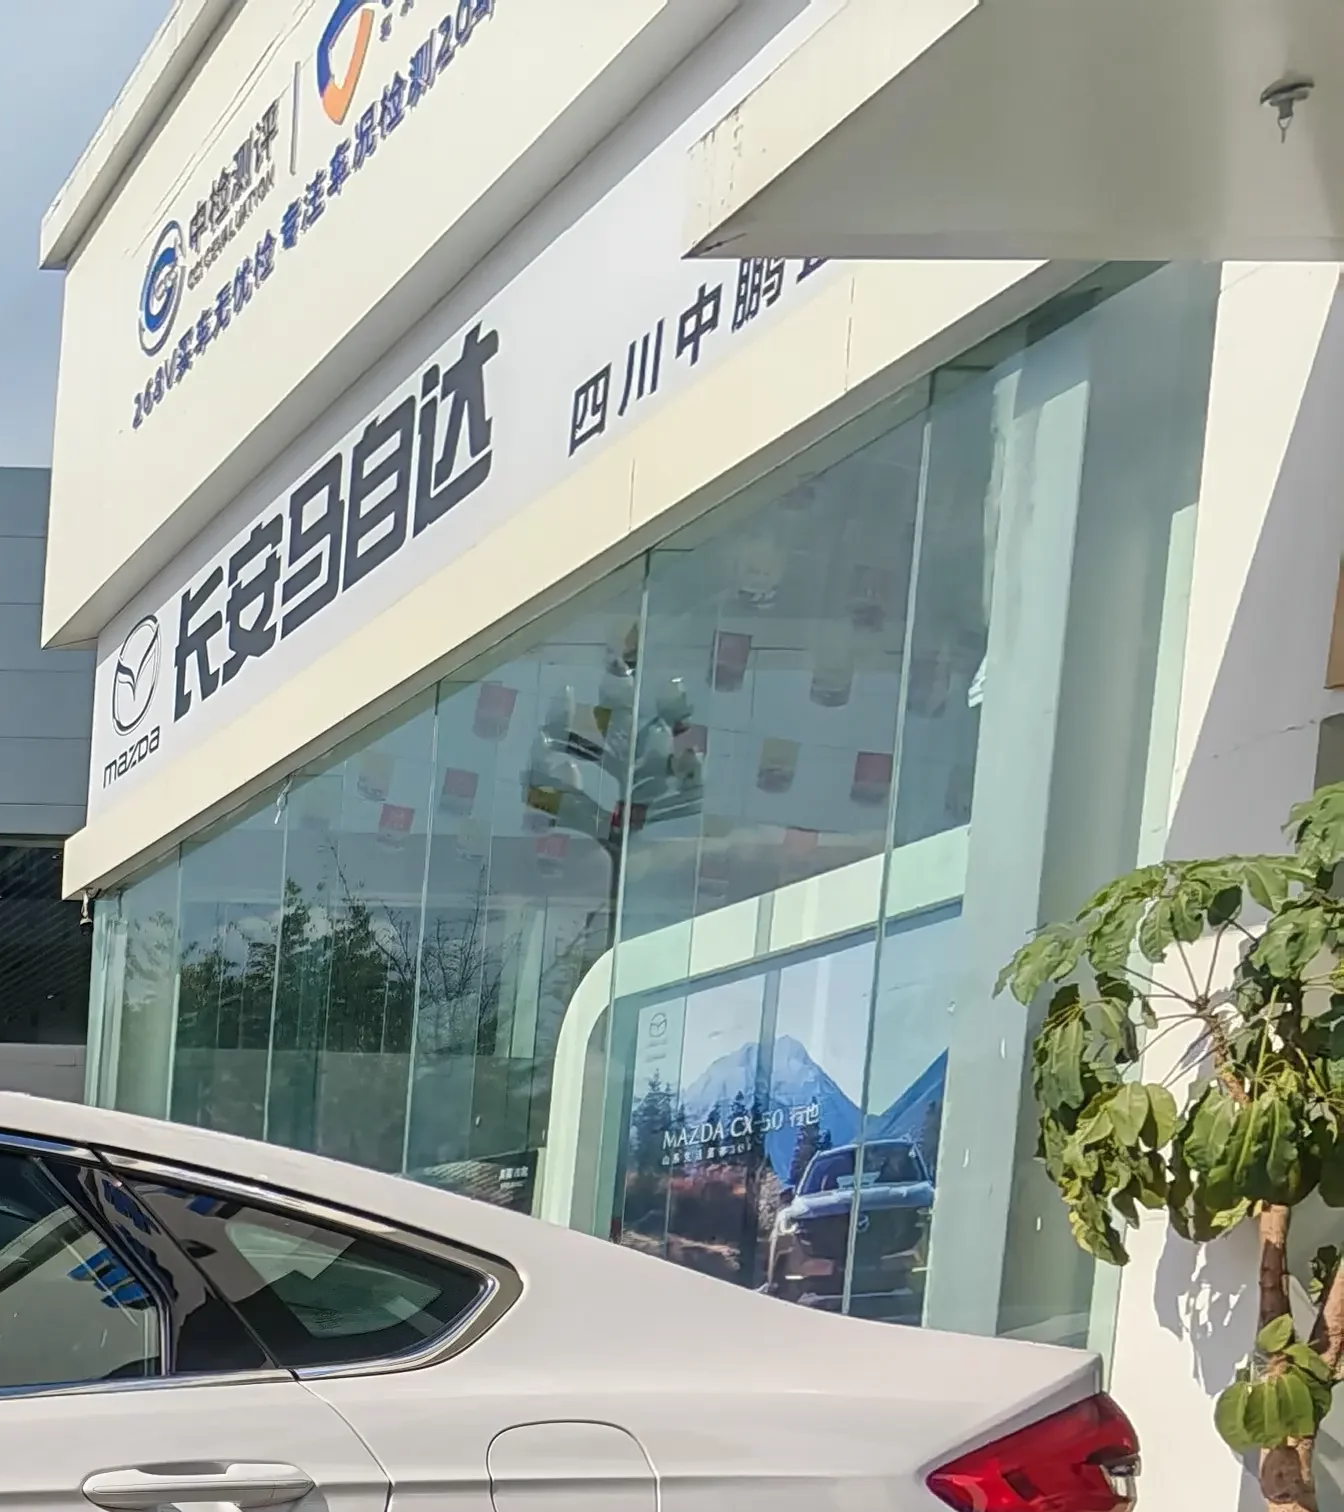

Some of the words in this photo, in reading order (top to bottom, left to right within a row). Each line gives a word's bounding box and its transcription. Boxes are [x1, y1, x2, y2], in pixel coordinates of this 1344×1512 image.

[568, 256, 828, 458] 四川中鹏
[174, 321, 500, 723] 长安马自达
[663, 1122, 725, 1149] MAZDA
[730, 1108, 784, 1138] CX-50
